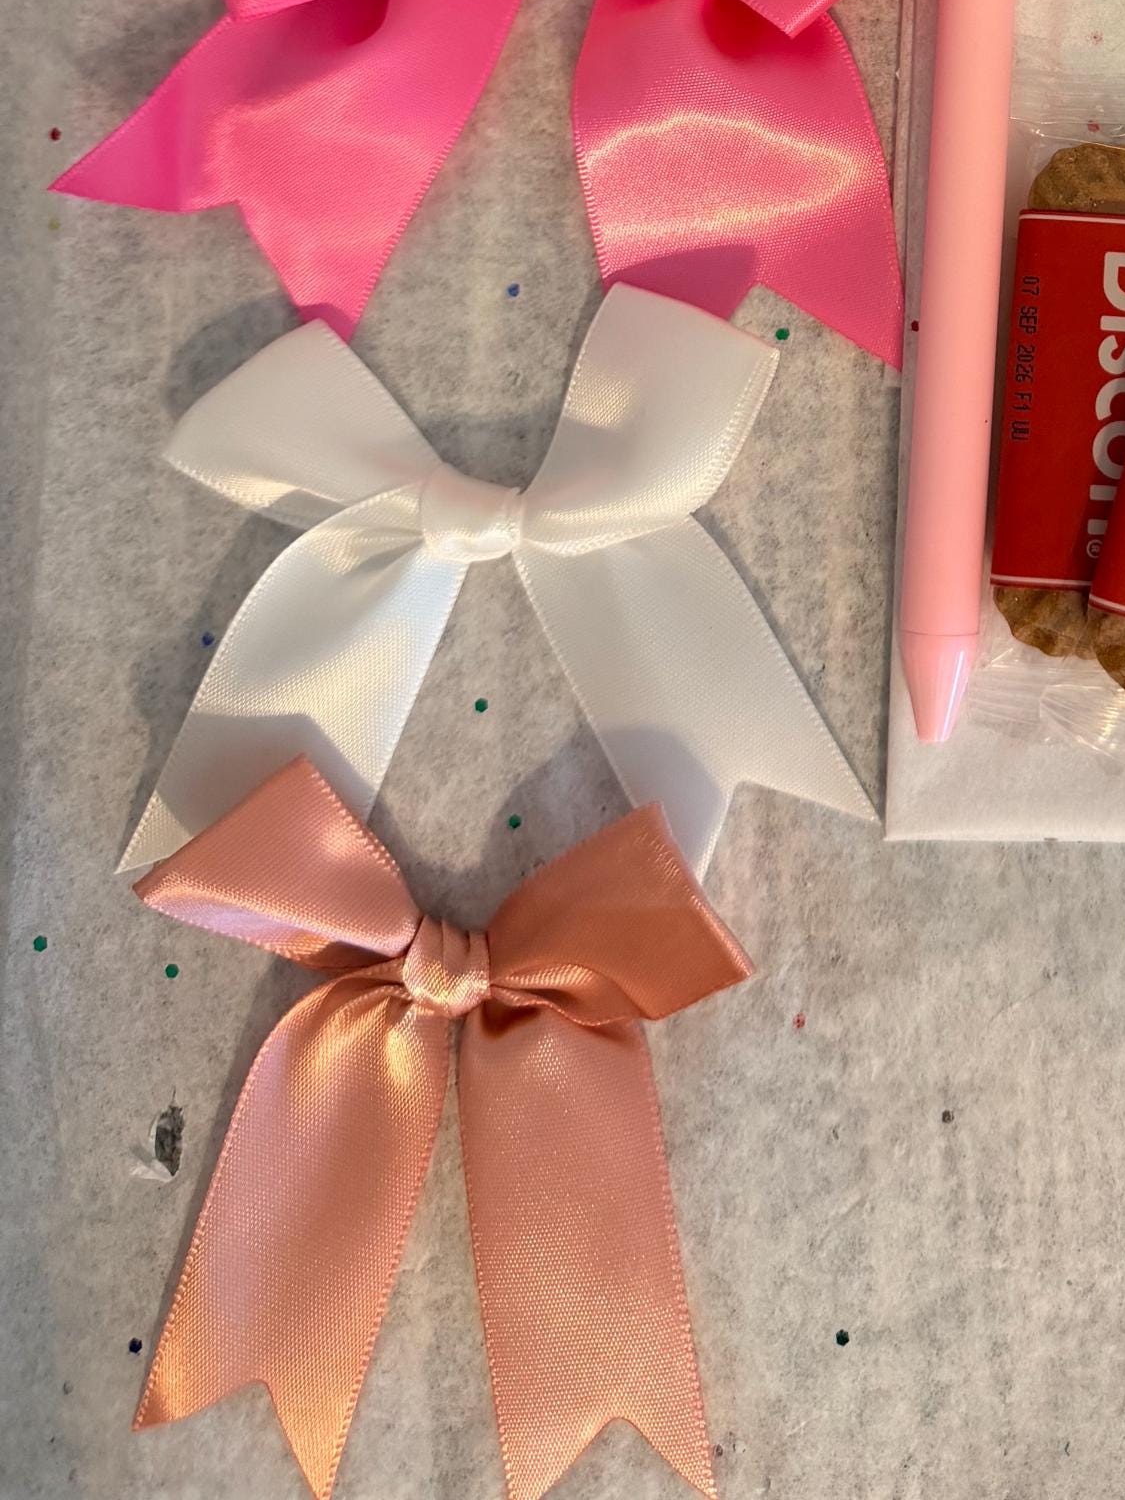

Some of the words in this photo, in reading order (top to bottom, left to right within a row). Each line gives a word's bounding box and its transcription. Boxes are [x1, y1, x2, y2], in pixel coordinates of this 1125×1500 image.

[1021, 275, 1040, 296] 07
[1018, 305, 1038, 335] SEP
[1015, 344, 1036, 384] 2026
